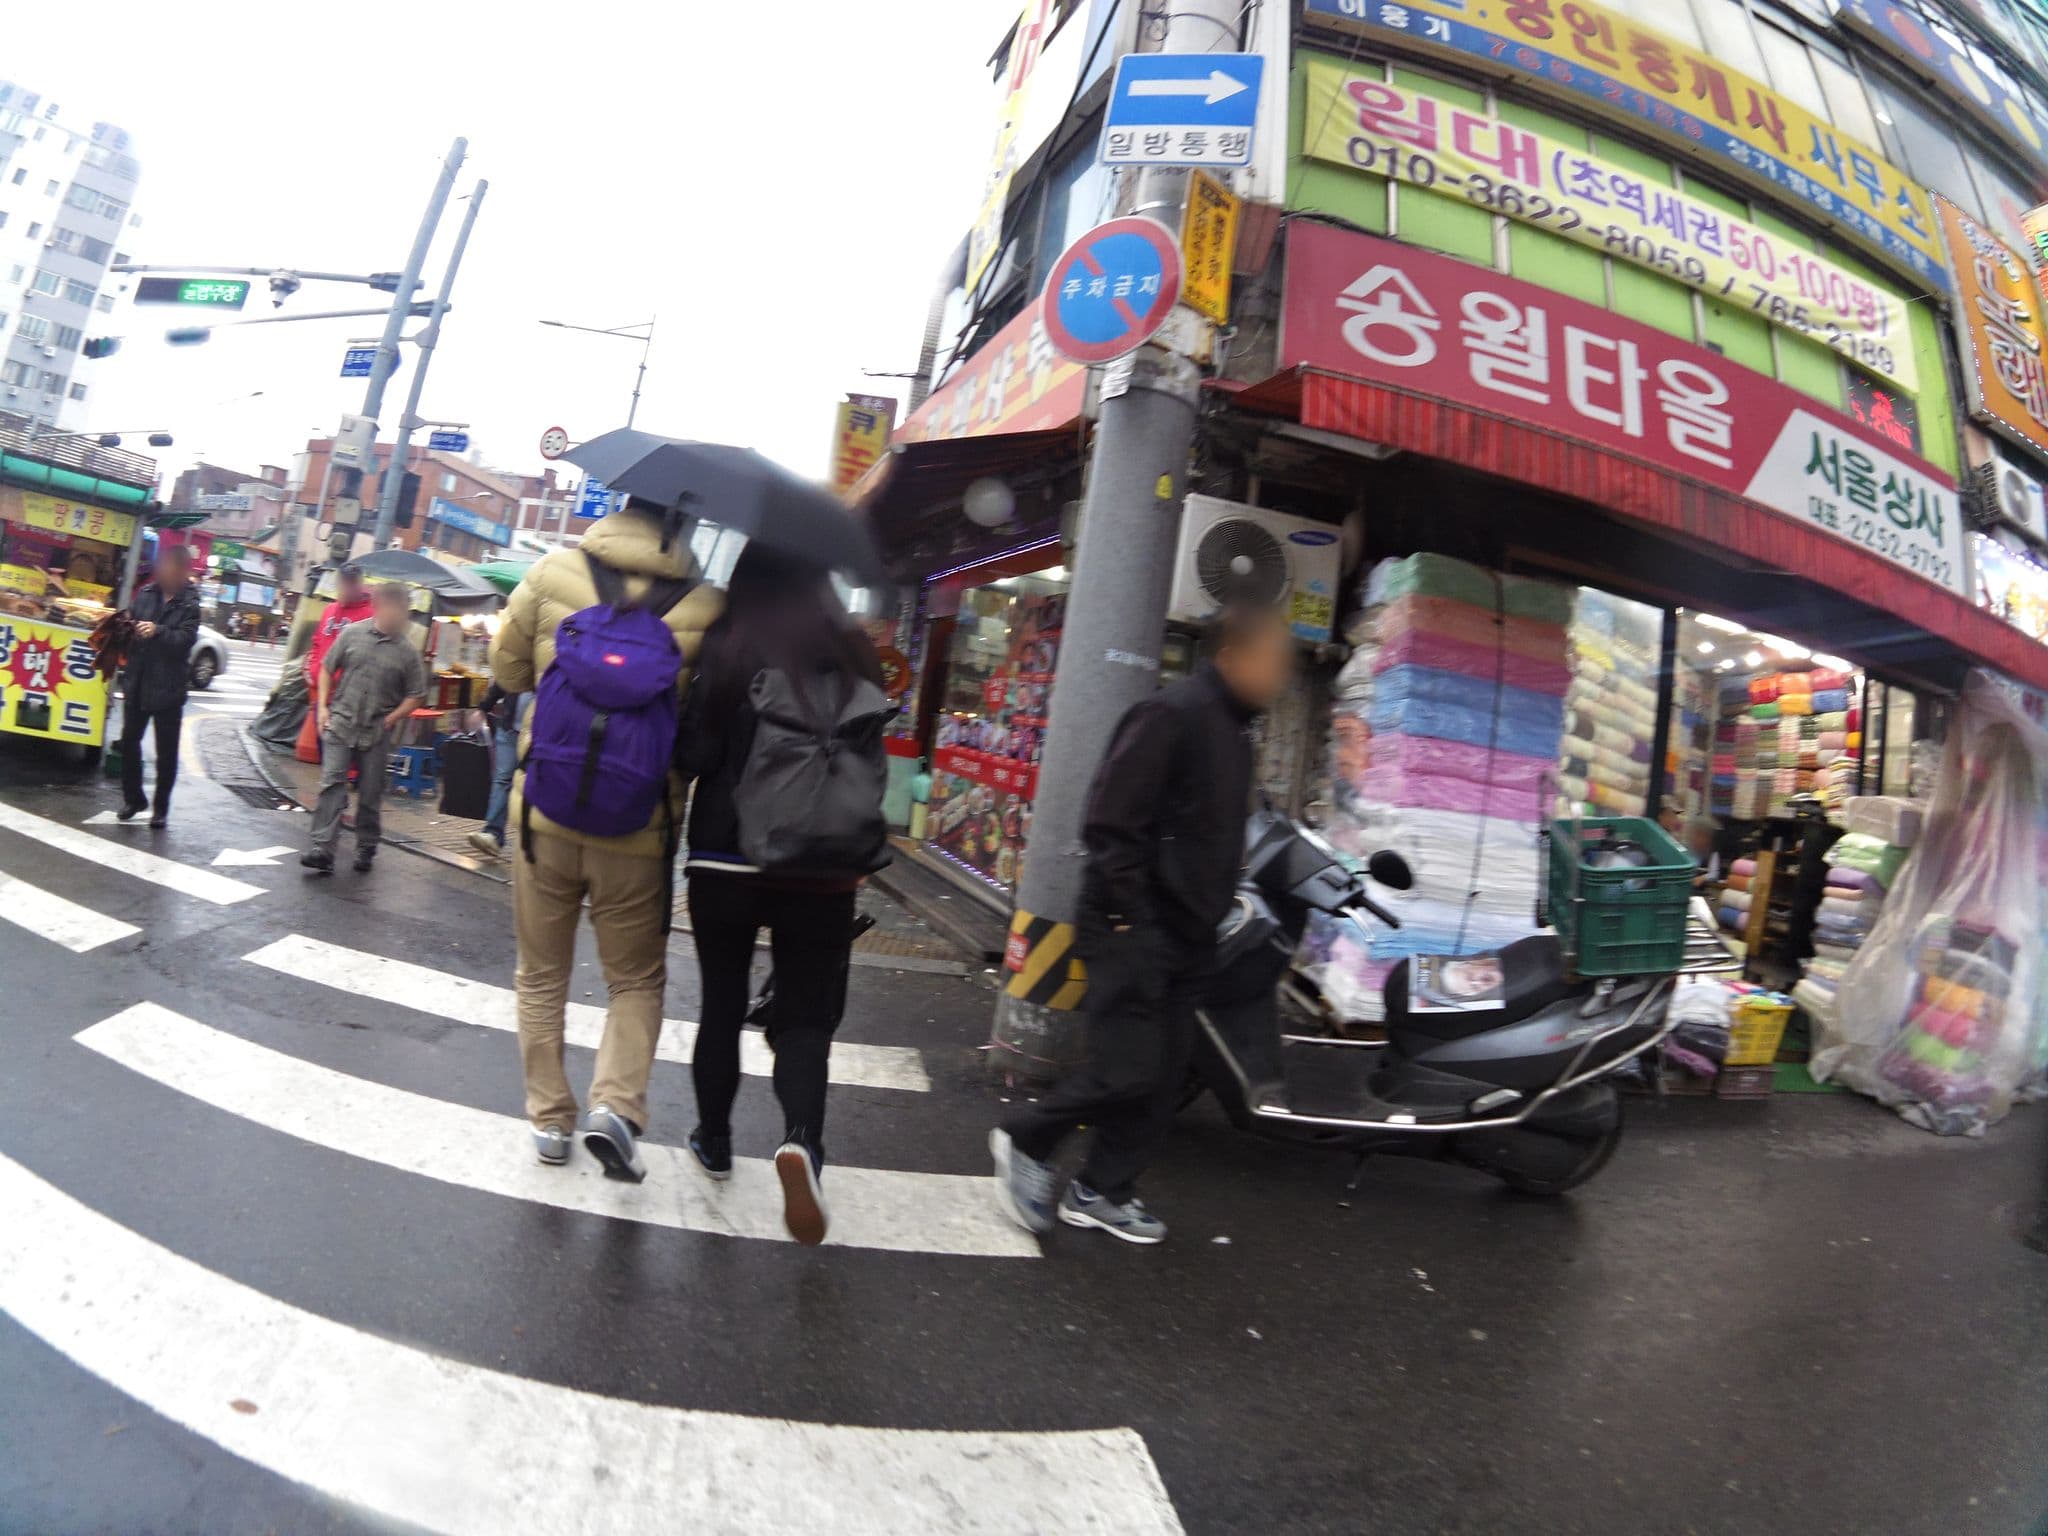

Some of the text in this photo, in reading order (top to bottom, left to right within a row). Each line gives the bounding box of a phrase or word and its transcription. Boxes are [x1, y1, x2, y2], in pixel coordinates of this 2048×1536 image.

[1109, 131, 1248, 158] 일방통행
[1347, 80, 1541, 188] 임대
[1063, 273, 1160, 299] 주차금지
[1348, 136, 1705, 285] 010-3622-8059
[1749, 283, 1894, 375] 765-2189
[1336, 264, 1734, 470] 송월타올
[1804, 431, 1944, 549] 서울상사
